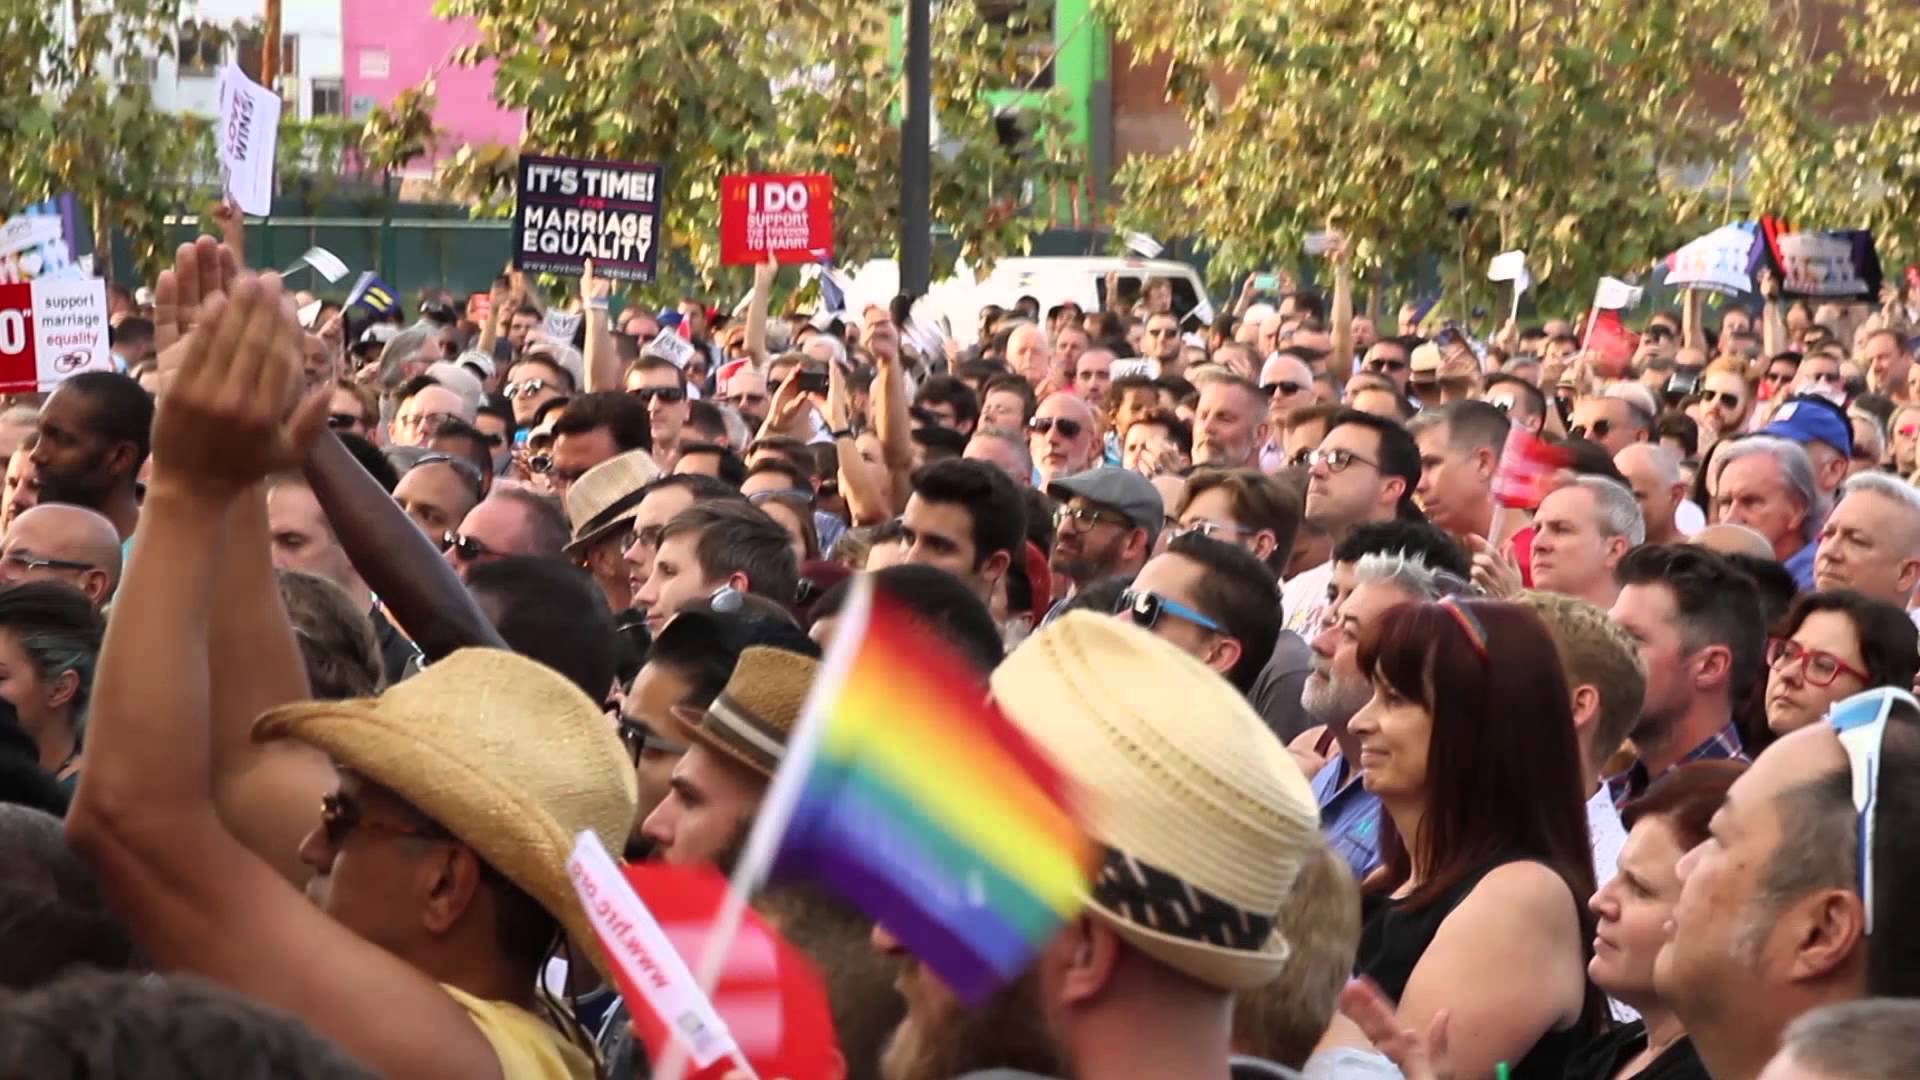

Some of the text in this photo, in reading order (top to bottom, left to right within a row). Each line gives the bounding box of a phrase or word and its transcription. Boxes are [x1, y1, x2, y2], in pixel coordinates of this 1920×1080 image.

[526, 164, 656, 202] IT'S TIME!
[524, 205, 653, 239] MARRIAGE
[748, 212, 808, 226] SUPPORT
[523, 228, 652, 263] EQUALITY
[748, 239, 808, 250] TO MARRY
[45, 294, 94, 310] support
[42, 313, 99, 328] marriage
[46, 333, 98, 348] equality
